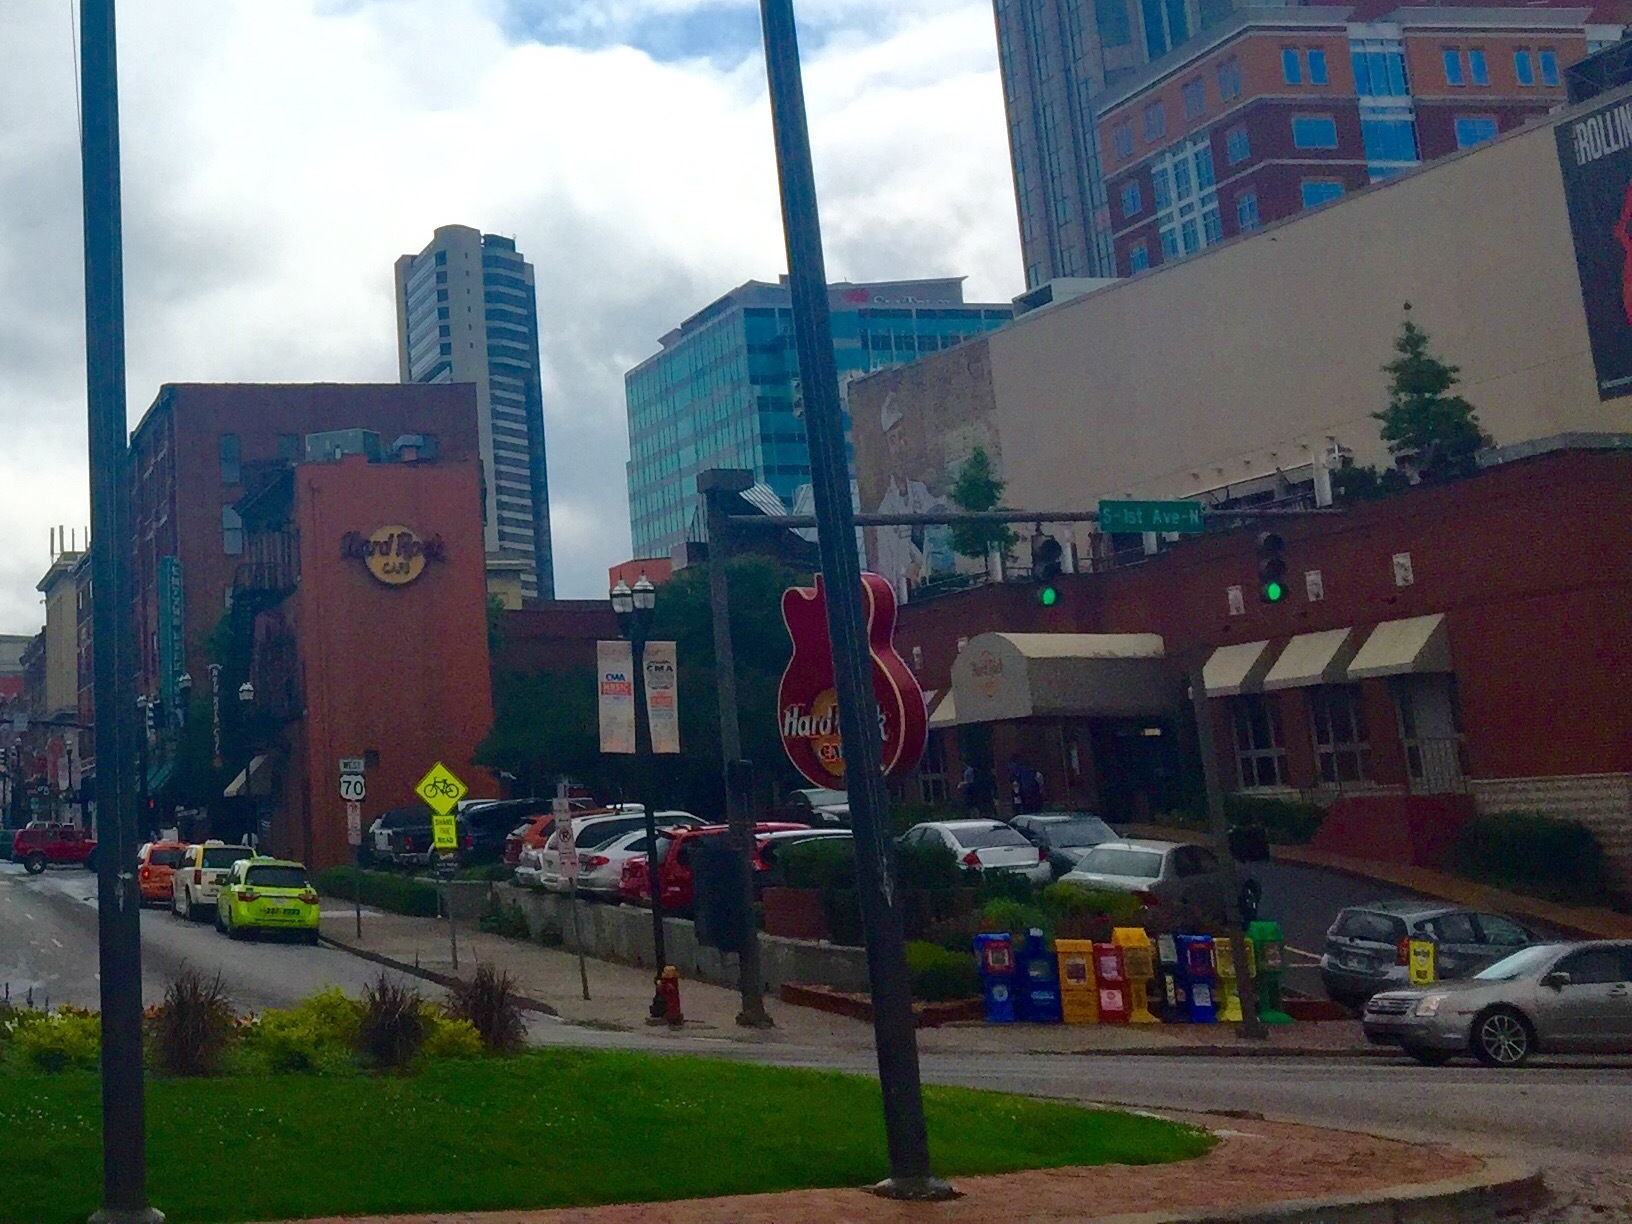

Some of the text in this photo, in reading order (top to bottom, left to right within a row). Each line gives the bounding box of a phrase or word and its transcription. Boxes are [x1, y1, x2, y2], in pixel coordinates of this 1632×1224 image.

[396, 531, 447, 563] Rock
[783, 704, 839, 737] Hard
[342, 780, 364, 796] 70
